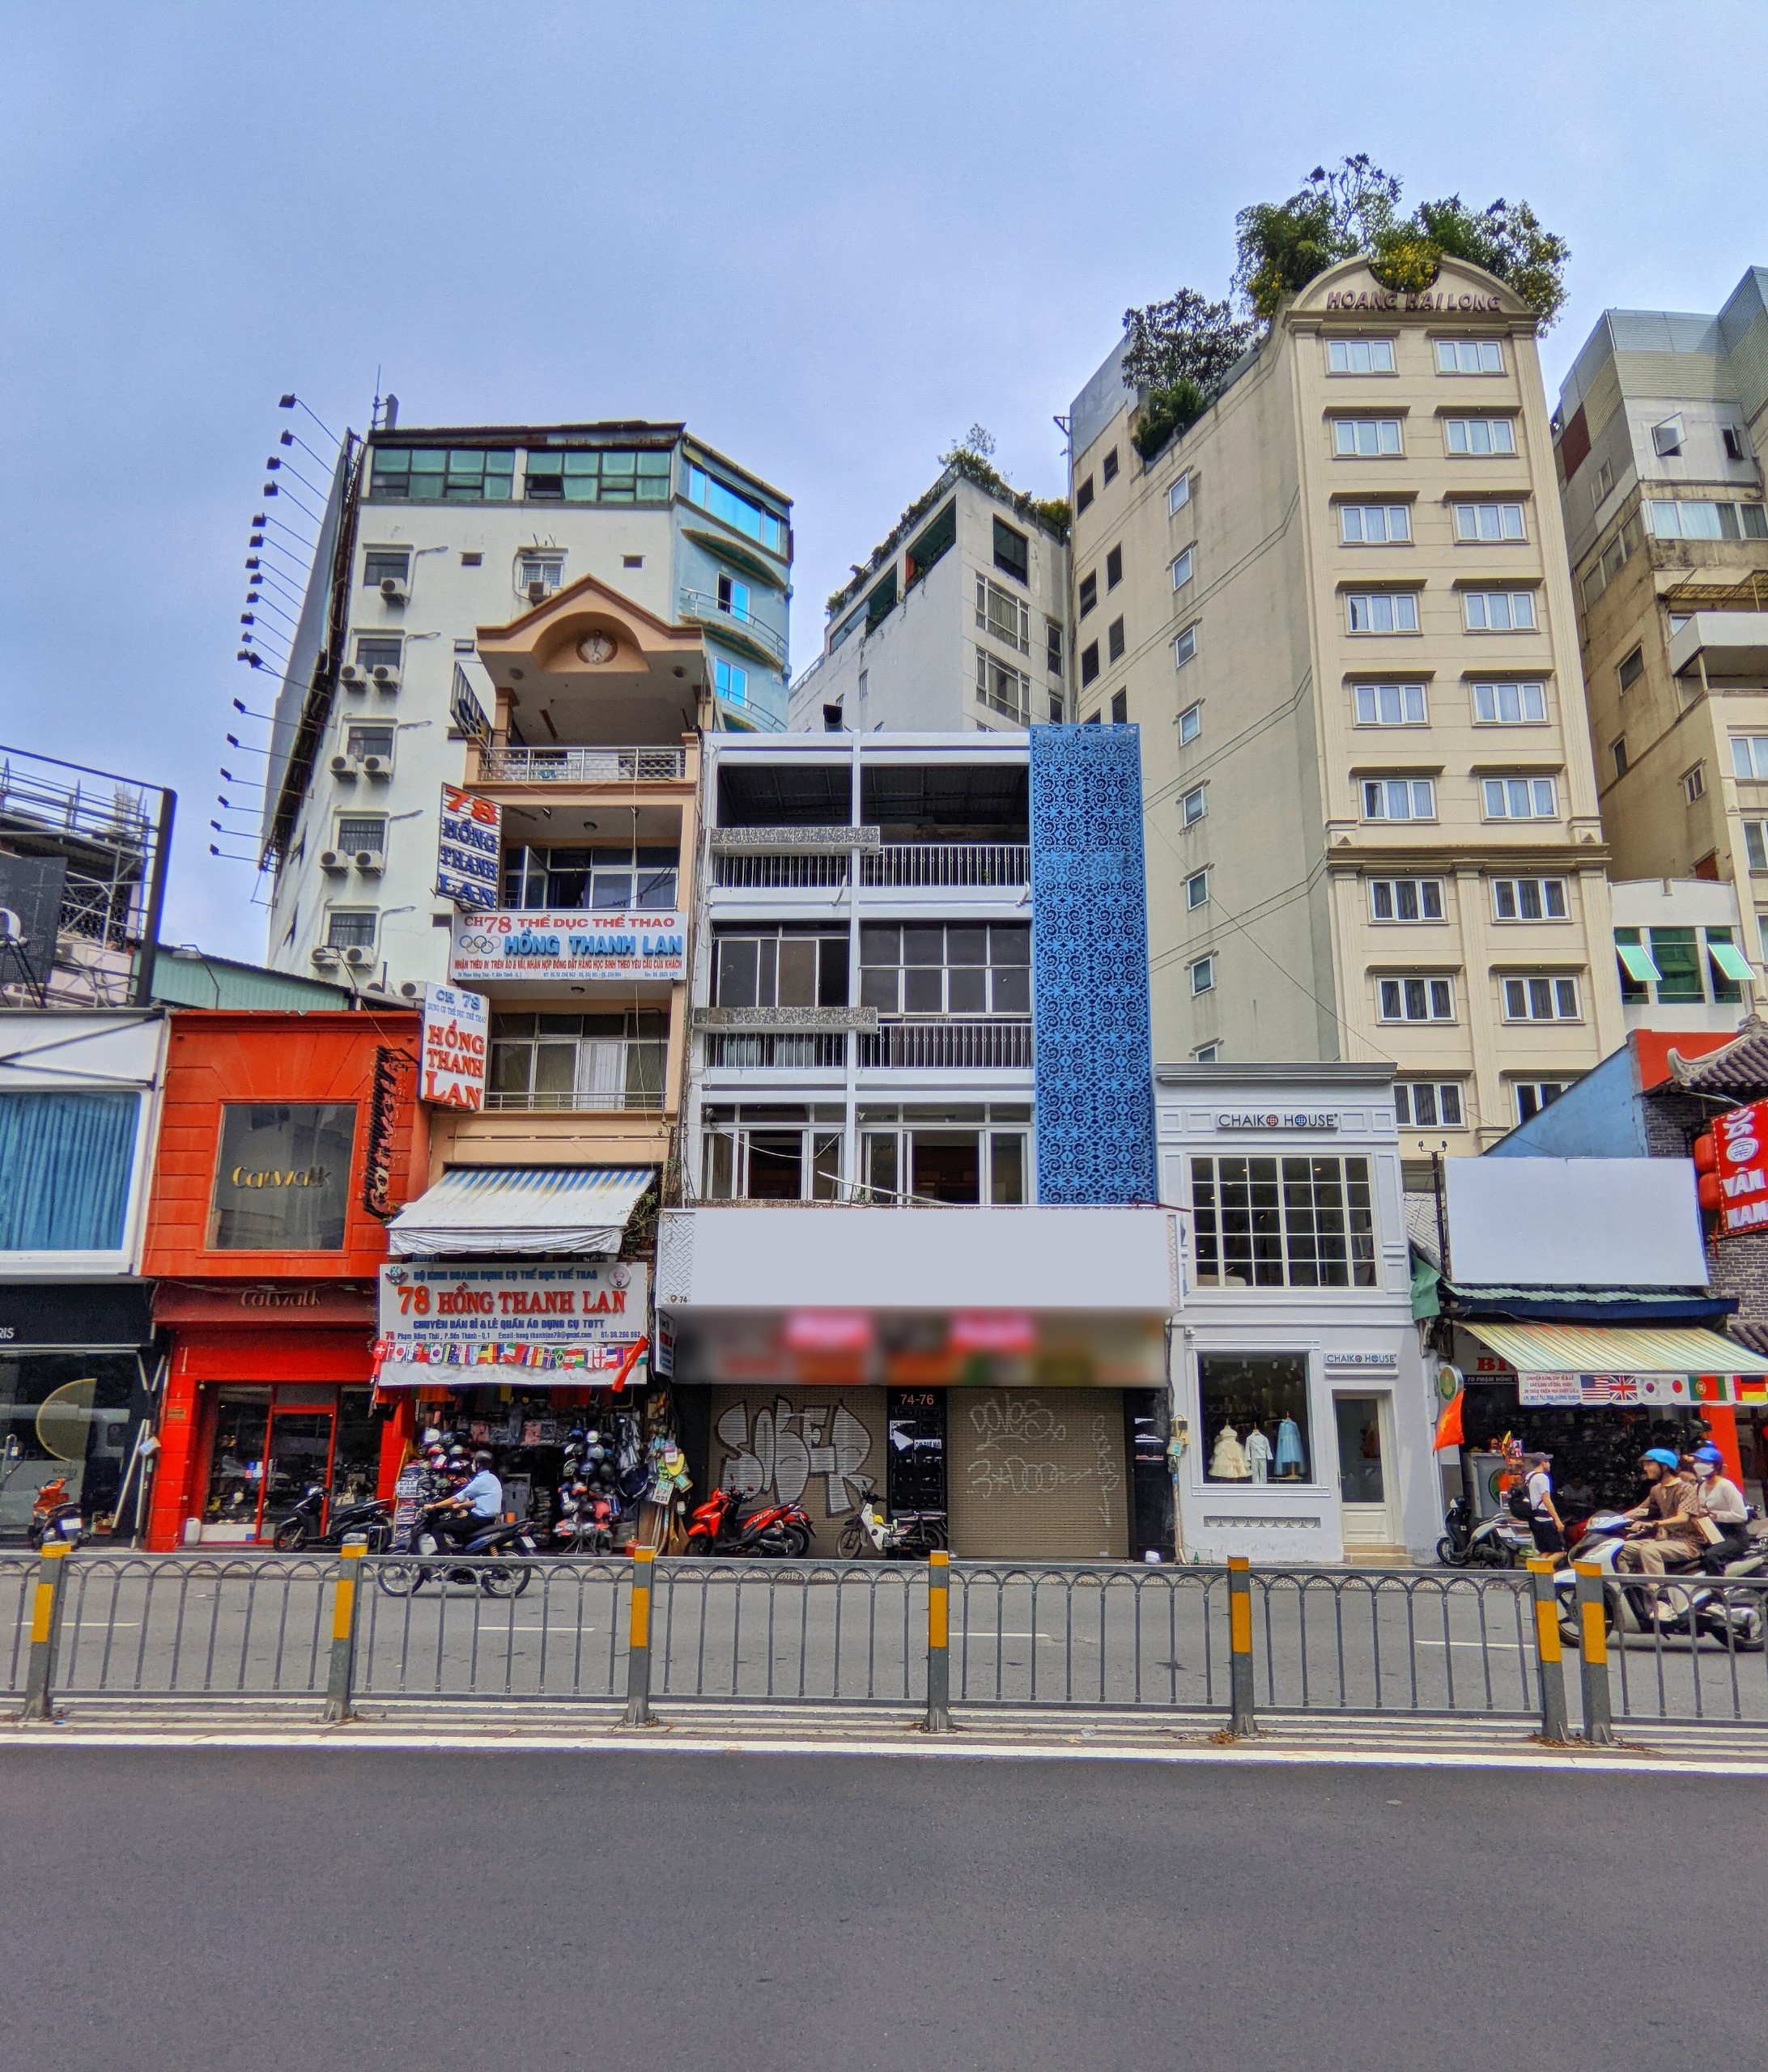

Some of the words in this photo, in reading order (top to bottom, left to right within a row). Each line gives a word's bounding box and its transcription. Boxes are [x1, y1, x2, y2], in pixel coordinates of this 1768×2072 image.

[1446, 293, 1502, 313] LONG
[445, 786, 498, 825] 78
[440, 844, 498, 882] THANH
[438, 872, 496, 910] LAN
[517, 914, 551, 928] THỂ
[553, 918, 589, 931] DỤC
[593, 914, 626, 928] THỂ
[628, 917, 675, 928] THAO
[568, 935, 636, 956] THANH
[643, 935, 682, 956] LAN
[618, 959, 631, 970] THEO
[436, 989, 455, 1004] CH
[461, 993, 480, 1011] 78
[427, 1047, 484, 1079] THANH
[424, 1070, 483, 1111] LAN
[1218, 1114, 1279, 1127] CHAIKO
[1721, 1166, 1766, 1198] VÂN
[1725, 1200, 1768, 1229] NAM
[397, 1285, 431, 1314] 78
[437, 1281, 495, 1314] HỒNG
[498, 1291, 575, 1314] THANH
[582, 1290, 627, 1314] LAN
[679, 1296, 687, 1304] 74
[413, 1318, 448, 1329] CHUYÊN
[449, 1318, 468, 1329] BÁN
[526, 1318, 539, 1329] ÁO
[385, 1331, 395, 1340] 78
[1327, 1354, 1362, 1363] CHAIKO
[900, 1394, 935, 1405] 74-76
